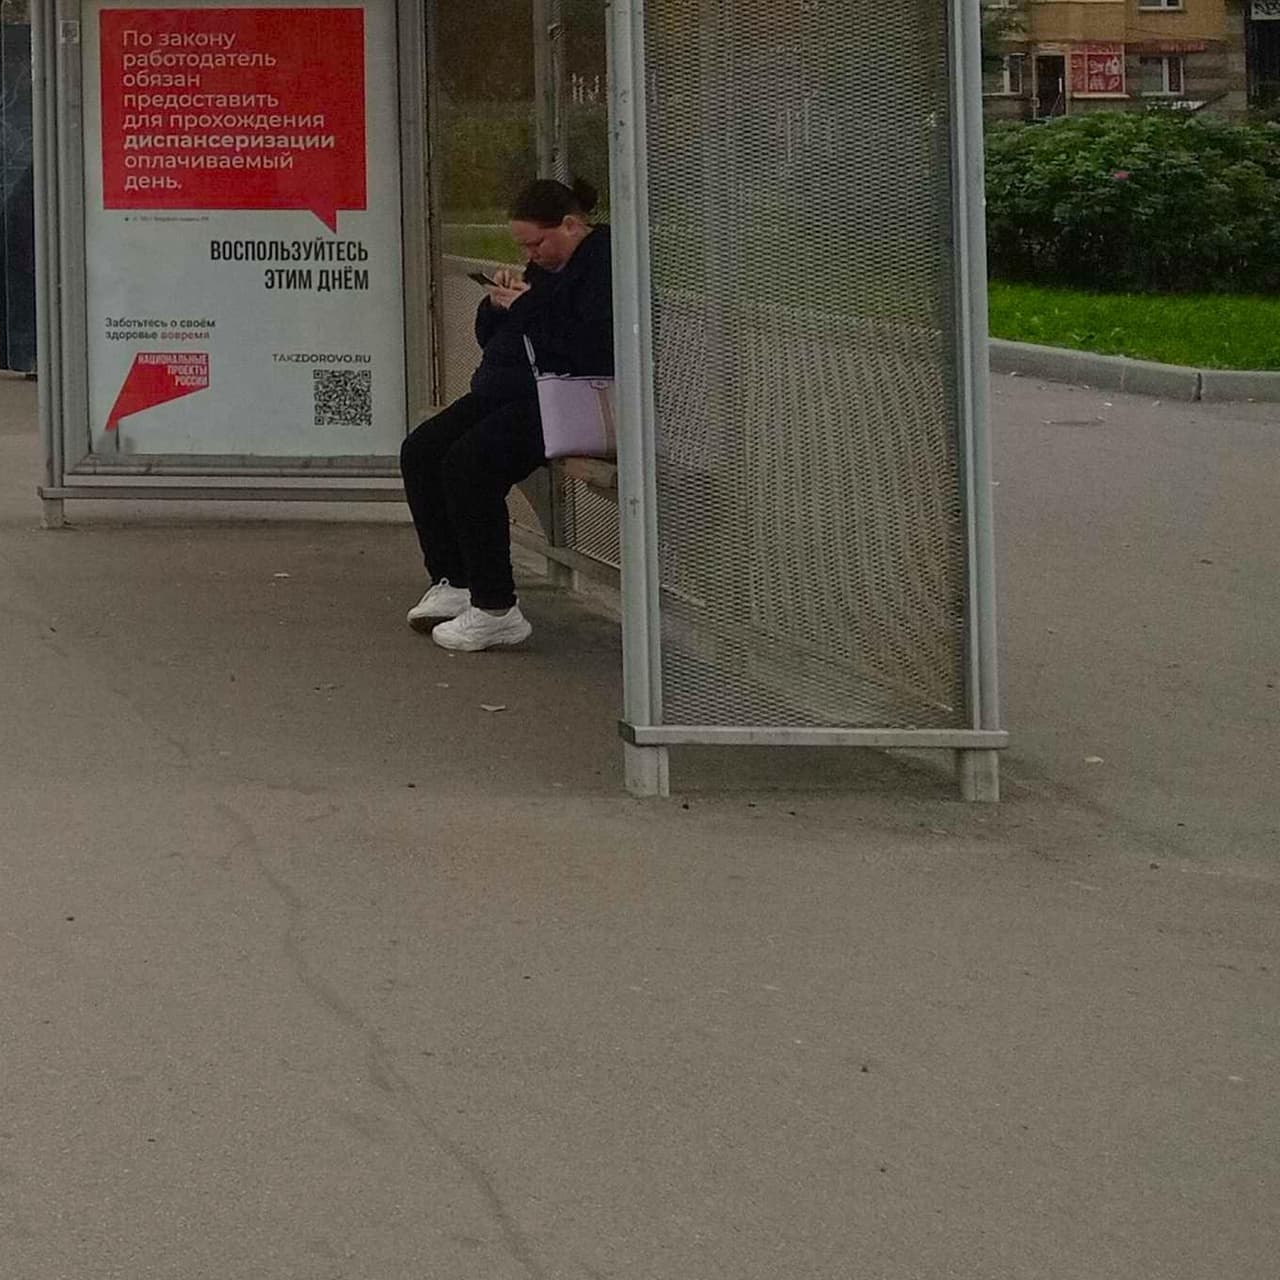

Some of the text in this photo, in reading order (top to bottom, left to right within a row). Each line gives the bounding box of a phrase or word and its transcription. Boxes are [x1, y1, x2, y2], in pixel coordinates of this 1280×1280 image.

[123, 30, 237, 50] По закону
[123, 49, 277, 70] работодатель
[123, 70, 201, 88] обязан
[123, 92, 280, 111] предоставить
[123, 113, 325, 130] для прохождения
[123, 133, 336, 151] диспансеризации
[124, 151, 294, 169] оплачиваемый
[124, 173, 182, 190] день.
[210, 237, 369, 262] ВОСПОЛЬЗУЙТЕСЬ
[263, 265, 370, 293] ЭТИМ ДНЁМ
[105, 317, 168, 329] Заботьтесь
[170, 319, 178, 328] о
[105, 330, 210, 341] здоровье вовремя
[137, 353, 207, 365] НАЦИОНАЛЬНЫЕ
[272, 353, 372, 364] TAKZDOROVO.RU
[167, 365, 207, 376] ПРОЕКТЫ
[174, 375, 208, 386] РОССИИ
